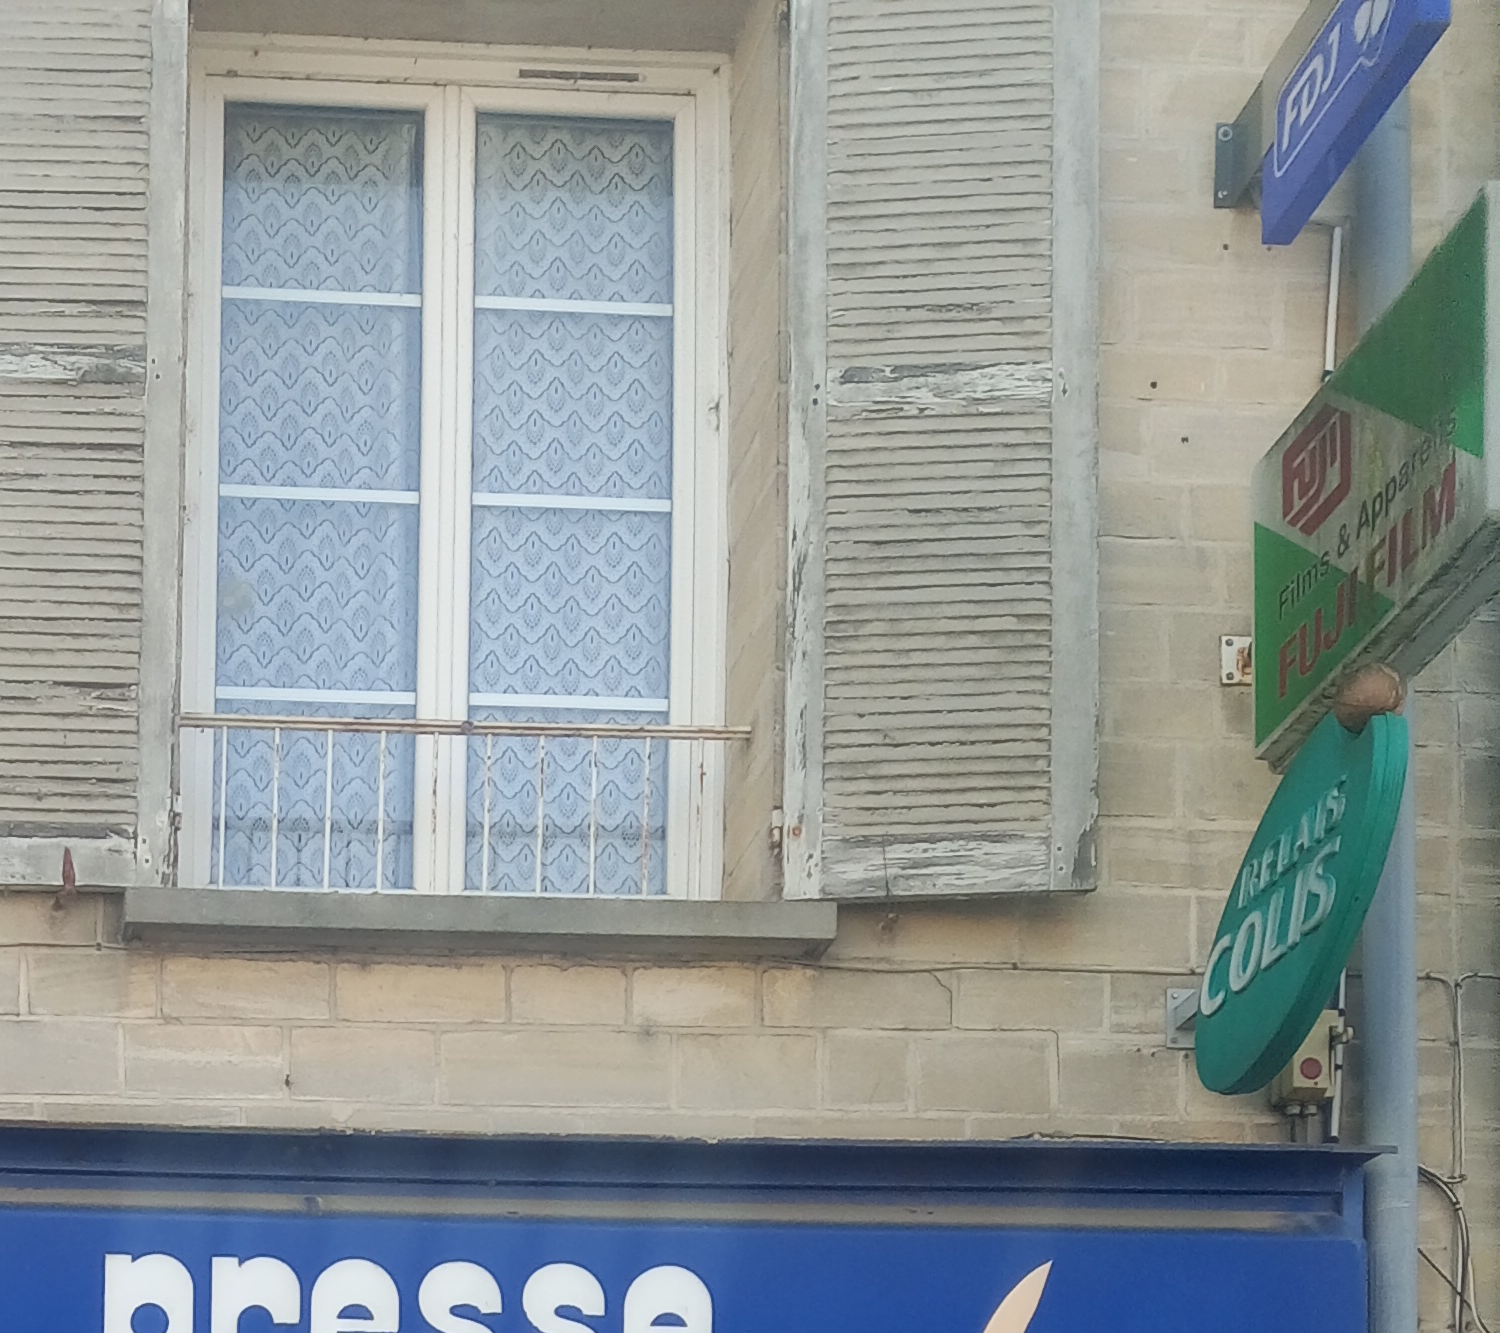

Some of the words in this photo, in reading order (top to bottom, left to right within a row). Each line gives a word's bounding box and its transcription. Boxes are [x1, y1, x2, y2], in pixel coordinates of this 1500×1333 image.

[1282, 22, 1342, 152] FDJ
[1279, 551, 1330, 620] Films
[1336, 523, 1351, 559] &
[1356, 407, 1457, 540] Appareils
[1238, 776, 1347, 910] RELAIS
[1199, 836, 1341, 1018] COLIS
